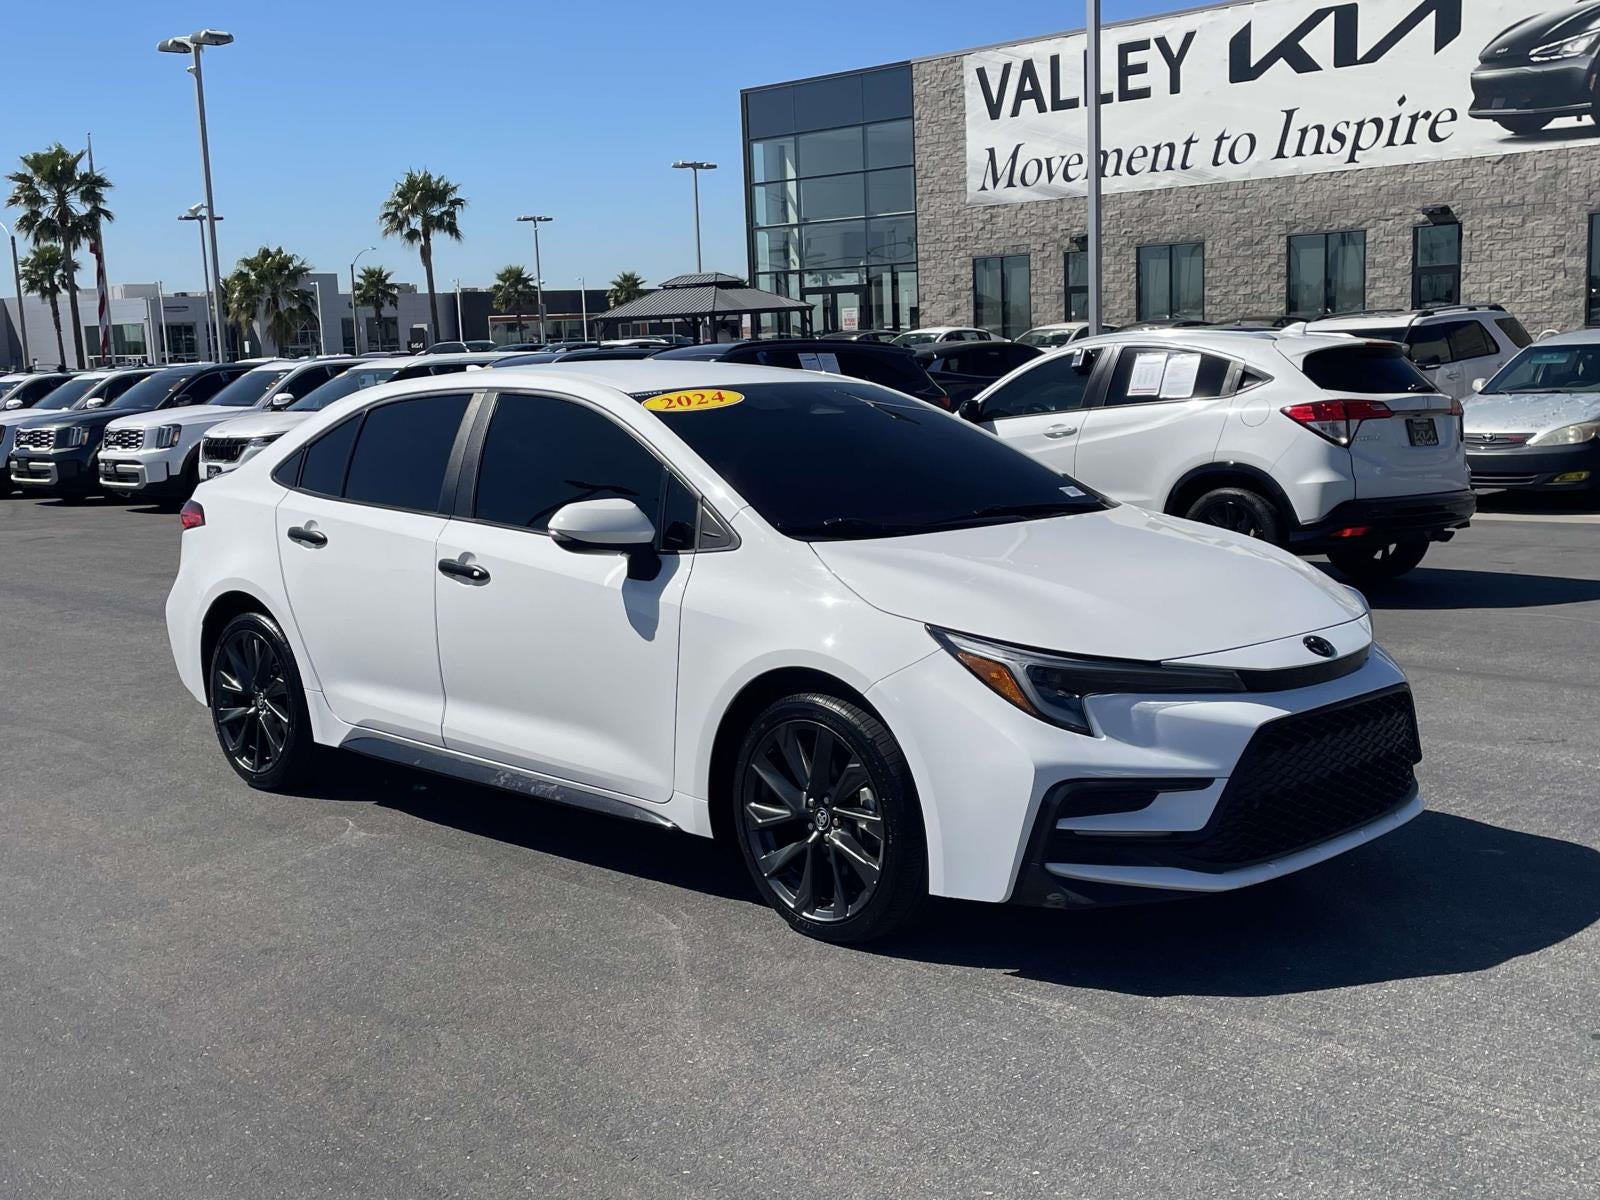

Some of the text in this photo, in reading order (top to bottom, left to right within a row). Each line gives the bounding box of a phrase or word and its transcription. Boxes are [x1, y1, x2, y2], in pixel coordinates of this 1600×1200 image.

[1229, 0, 1462, 84] KIA
[977, 94, 1458, 193] Movement to Inspire
[660, 391, 726, 410] 2024
